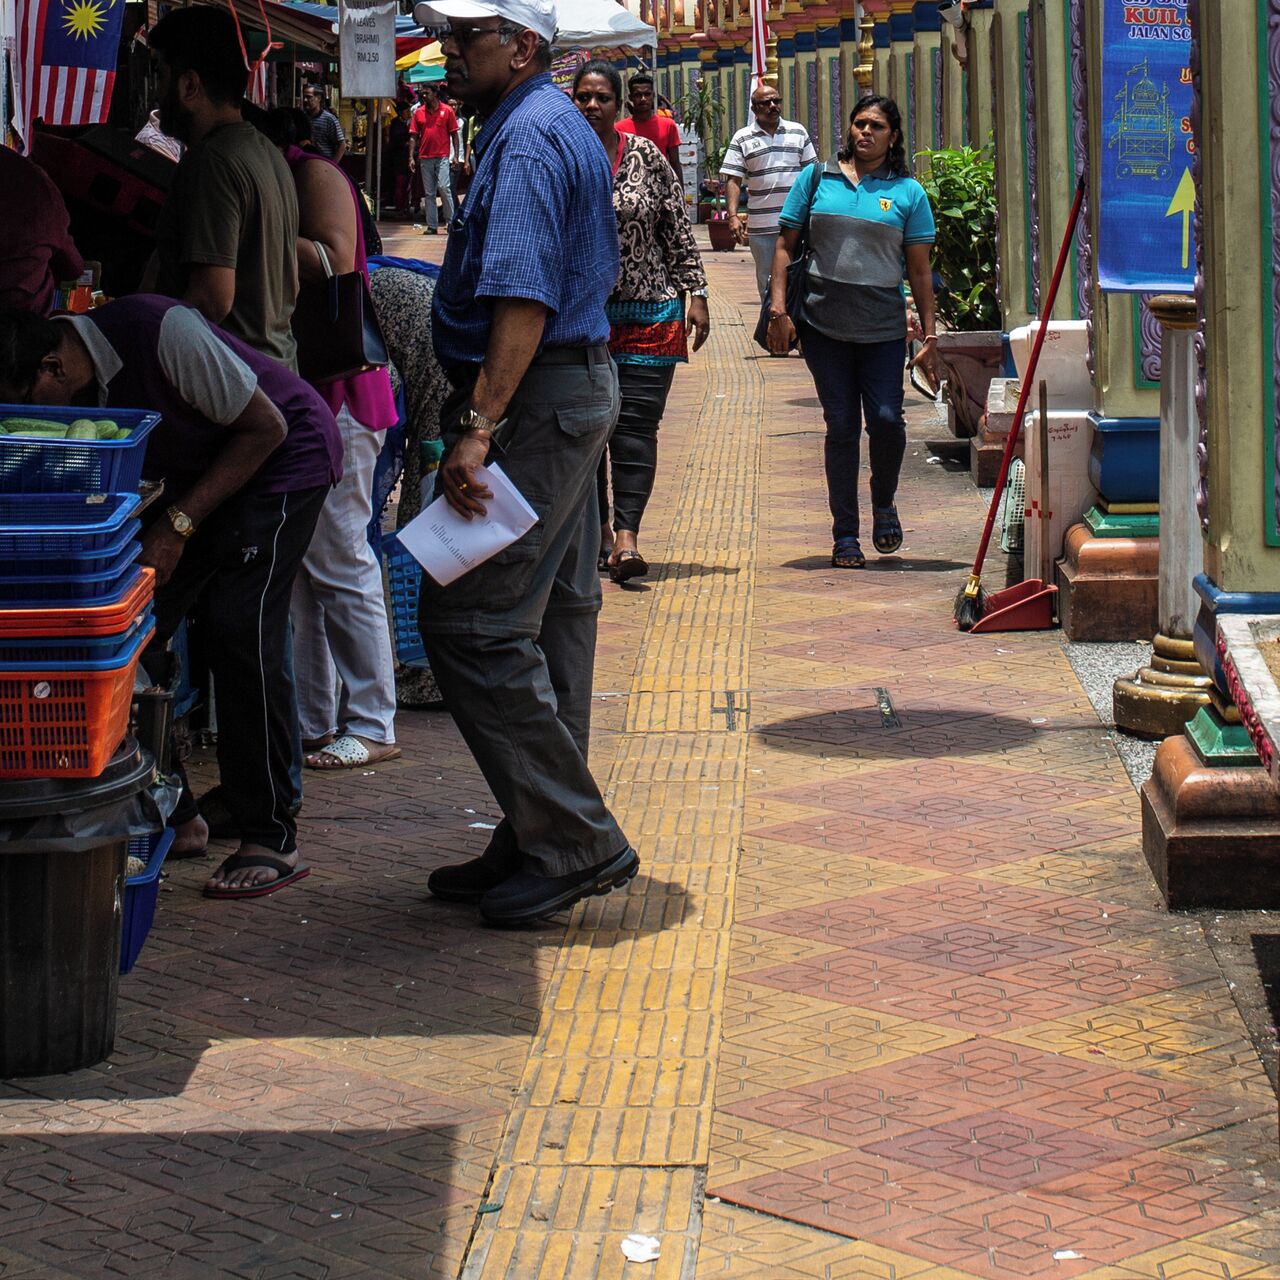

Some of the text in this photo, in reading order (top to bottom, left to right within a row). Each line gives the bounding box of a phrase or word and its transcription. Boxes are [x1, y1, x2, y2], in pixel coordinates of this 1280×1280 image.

[356, 17, 376, 28] LEAVES
[1124, 7, 1182, 26] KUIL
[1128, 26, 1169, 40] JALAN
[354, 34, 380, 46] (BRAHMI)
